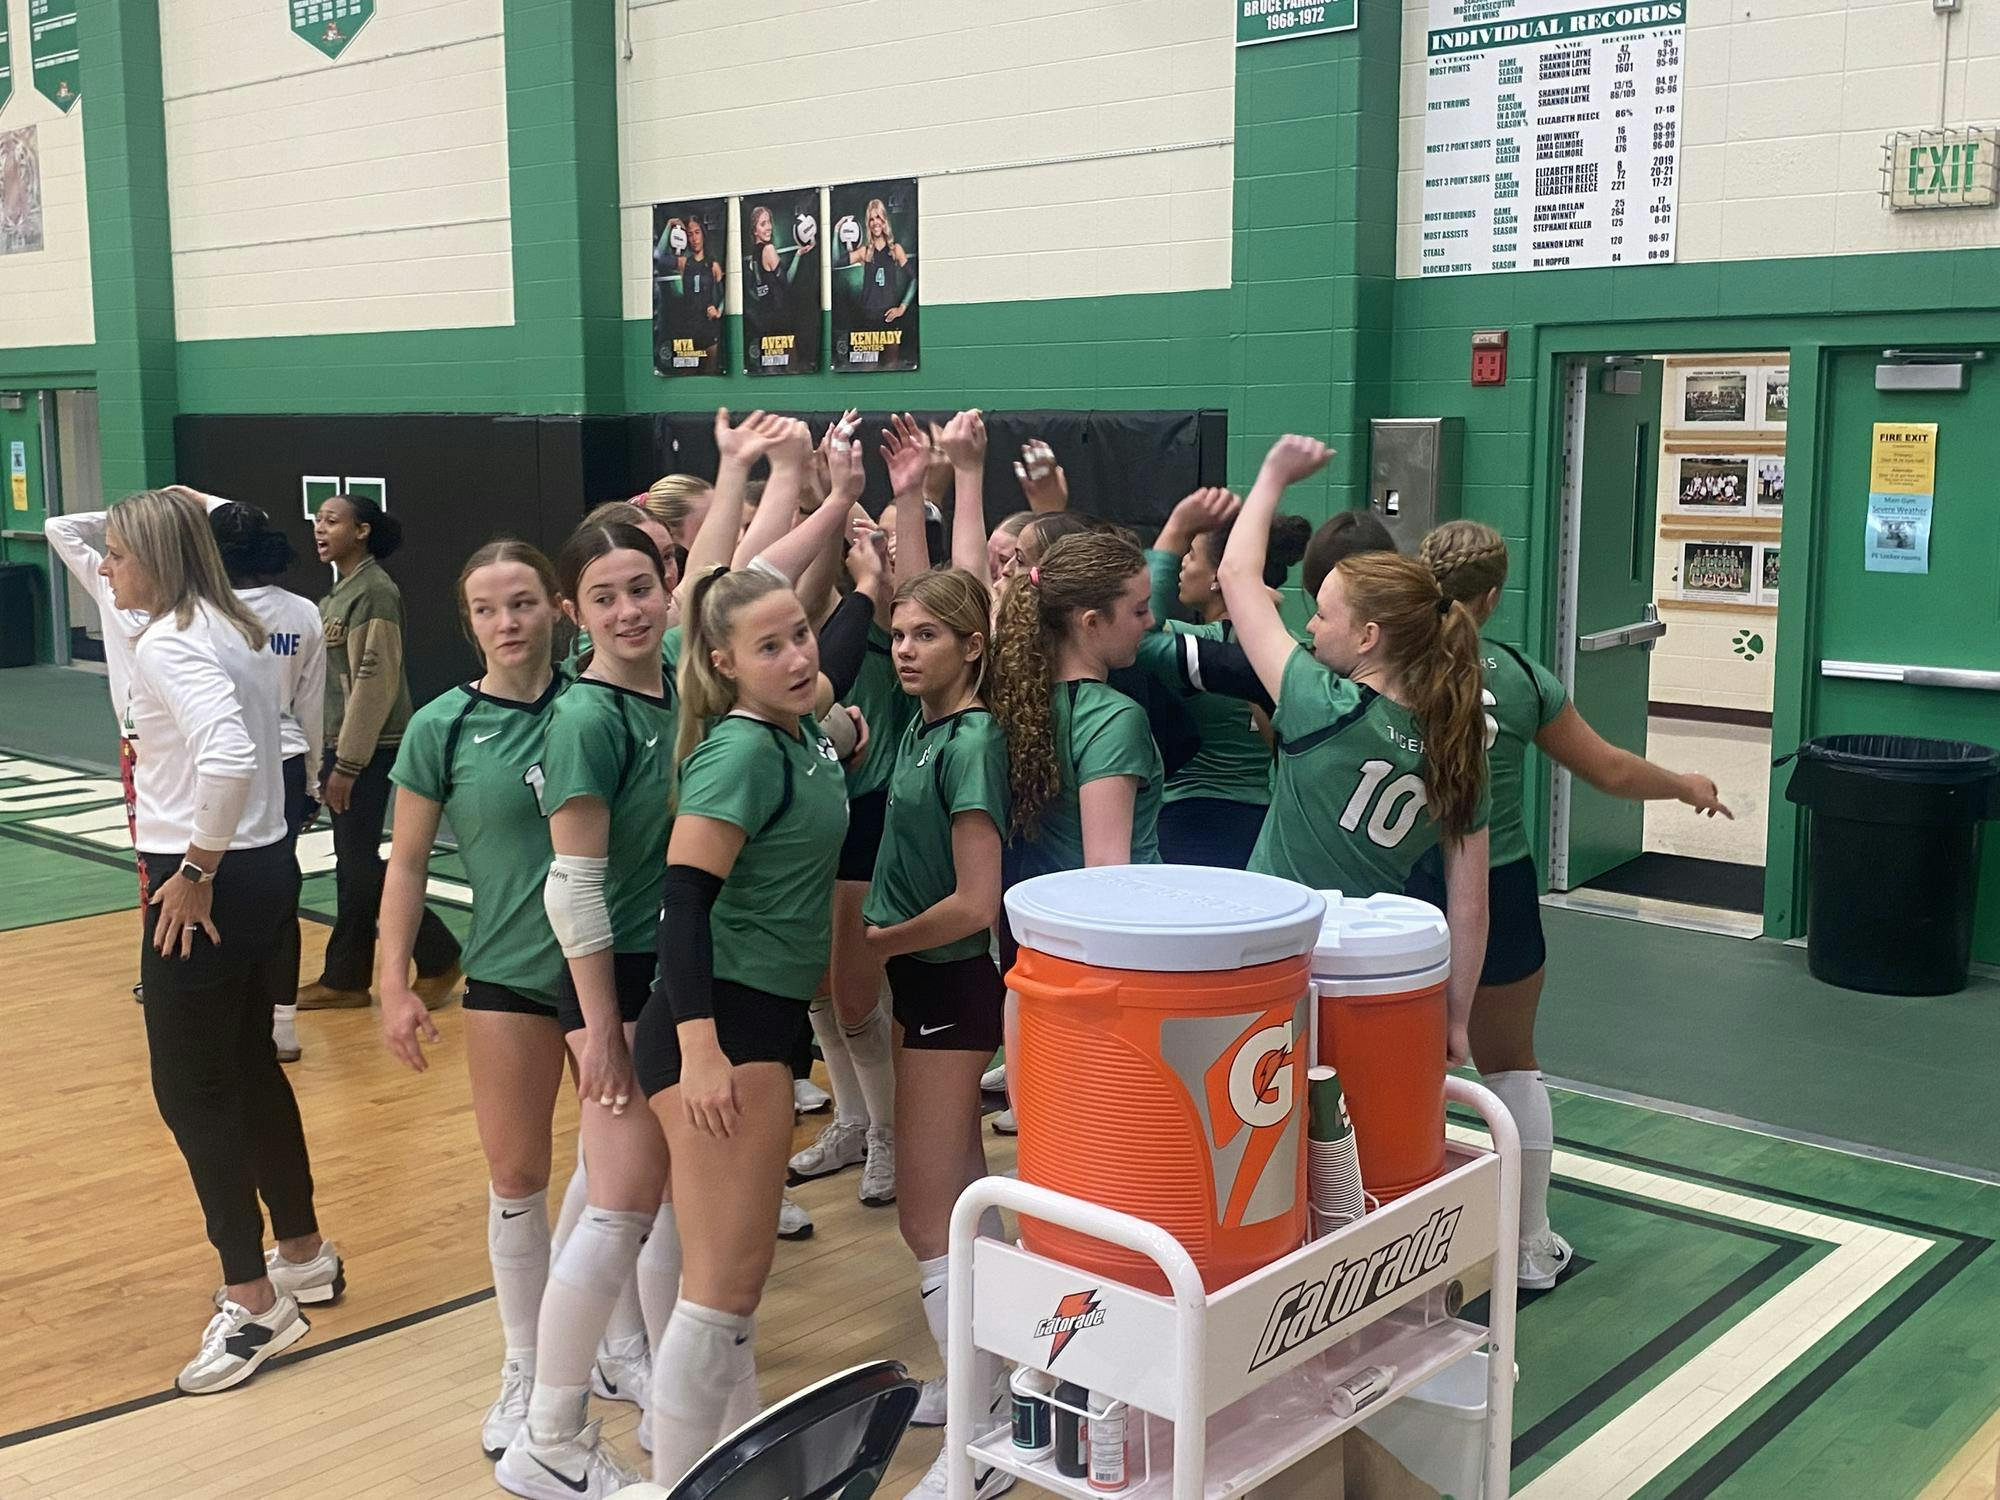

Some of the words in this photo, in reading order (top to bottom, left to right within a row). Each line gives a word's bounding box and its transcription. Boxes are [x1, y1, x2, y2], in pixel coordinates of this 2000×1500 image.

[1243, 0, 1282, 17] BRUCE
[1453, 5, 1471, 15] MOST
[1472, 0, 1516, 13] CONSECUTIVE
[1266, 7, 1325, 30] 1968-1972
[1463, 12, 1481, 22] HOME
[1482, 10, 1500, 20] WINS
[1431, 19, 1564, 50] INDIVIDUAL
[1570, 2, 1682, 32] RECORDS
[1601, 33, 1645, 44] RECORD
[1652, 29, 1682, 38] YEAR
[1555, 41, 1583, 50] NAME
[1663, 39, 1673, 48] 95
[1539, 50, 1571, 63] SHANNON
[1572, 48, 1592, 59] LAYNE
[1617, 52, 1630, 63] 577
[1657, 47, 1679, 58] 93-97
[1435, 53, 1485, 65] CATEGORY
[1498, 57, 1517, 68] GAME
[1539, 60, 1571, 72] SHANNON
[1571, 57, 1591, 68] LAYNE
[1656, 57, 1679, 67] 95-96
[1429, 66, 1447, 76] MOST
[1447, 63, 1471, 75] POINTS
[1498, 66, 1524, 77] SEASON
[1539, 69, 1571, 81] SHANNON
[1571, 66, 1591, 77] LAYNE
[1615, 63, 1634, 73] 1601
[1498, 75, 1523, 85] CAREER
[1613, 80, 1633, 90] 13/15
[1668, 75, 1678, 84] 97
[1538, 86, 1570, 98] SHANNON
[1570, 84, 1590, 95] LAYNE
[1609, 89, 1636, 100] 86/109
[1655, 84, 1677, 95] 95-96
[1497, 93, 1516, 103] GAME
[1537, 95, 1570, 108] SHANNON
[1570, 93, 1590, 104] LAYNE
[1428, 101, 1442, 111] FREE
[1443, 98, 1470, 109] THROWS
[1497, 101, 1522, 112] SEASON
[1655, 105, 1675, 114] 17-18
[1497, 112, 1504, 120] IN
[1505, 111, 1509, 119] A
[1511, 110, 1527, 119] ROW
[1537, 114, 1576, 125] ELIZABETH
[1576, 111, 1600, 122] REECE
[1615, 108, 1633, 118] 86%
[1496, 119, 1522, 129] SEASON
[1653, 121, 1676, 131] 05-06
[1496, 137, 1514, 146] GAME
[1536, 133, 1553, 142] ANDI
[1553, 130, 1580, 141] WINNEY
[1615, 135, 1627, 144] 176
[1426, 144, 1444, 153] MOST
[1445, 143, 1449, 152] 2
[1450, 141, 1469, 151] POINT
[1470, 139, 1491, 149] SHOTS
[1495, 145, 1521, 155] SEASON
[1536, 142, 1553, 152] JAMA
[1554, 139, 1584, 150] GILMORE
[1652, 140, 1675, 150] 96-00
[1495, 154, 1520, 164] CAREER
[1536, 150, 1553, 160] JAMA
[1554, 148, 1583, 159] GILMORE
[1653, 155, 1674, 166] 2019
[1535, 165, 1574, 178] ELIZABETH
[1575, 162, 1599, 174] REECE
[1617, 169, 1626, 179] 72
[1650, 166, 1674, 177] 20-21
[1908, 143, 1980, 196] EXIT
[1425, 178, 1443, 187] MOST
[1444, 177, 1449, 186] 3
[1450, 176, 1468, 185] POINT
[1469, 174, 1490, 184] SHOTS
[1494, 172, 1513, 181] GAME
[1535, 175, 1574, 188] ELIZABETH
[1575, 172, 1598, 183] REECE
[1652, 177, 1673, 187] 17-21
[1494, 181, 1520, 190] SEASON
[1535, 185, 1573, 196] ELIZABETH
[1574, 182, 1598, 193] REECE
[1611, 181, 1626, 191] 221
[1494, 189, 1519, 199] CAREER
[1614, 199, 1625, 208] 25
[1658, 196, 1666, 204] 17
[1493, 207, 1512, 216] GAME
[1534, 204, 1557, 213] JENNA
[1558, 202, 1585, 212] IRELAN
[1649, 204, 1672, 214] 04-05
[1424, 212, 1442, 221] MOST
[1442, 209, 1476, 220] REBOUNDS
[1493, 215, 1518, 225] SEASON
[1533, 213, 1550, 222] ANDI
[1550, 211, 1577, 220] WINNEY
[1532, 222, 1568, 232] STEPHANIE
[1568, 220, 1592, 230] KELLER
[1611, 218, 1623, 227] 125
[1424, 231, 1441, 240] MOST
[1442, 229, 1469, 239] ASSISTS
[1493, 226, 1518, 236] SEASON
[1610, 236, 1623, 245] 120
[1648, 233, 1670, 243] 96-97
[1492, 243, 1517, 253] SEASON
[1532, 241, 1564, 250] SHANNON
[1564, 238, 1584, 248] LAYNE
[1423, 248, 1445, 257] STEALS
[1648, 250, 1670, 260] 08-09
[1491, 261, 1517, 270] SEASON
[1545, 257, 1570, 266] HOPPER
[1422, 264, 1450, 274] BLOCKED
[1450, 263, 1472, 272] SHOTS
[875, 267, 885, 286] 4
[761, 335, 795, 349] AVERY
[850, 330, 902, 346] KENNADY
[673, 338, 694, 351] MYA
[1879, 433, 1902, 442] FIRE
[1905, 434, 1929, 442] EXIT
[1897, 506, 1927, 515] Weather
[1338, 758, 1429, 849] 10
[1228, 1018, 1295, 1128] G
[1248, 1205, 1464, 1374] Gatorade
[1033, 1309, 1107, 1338] Gatorade
